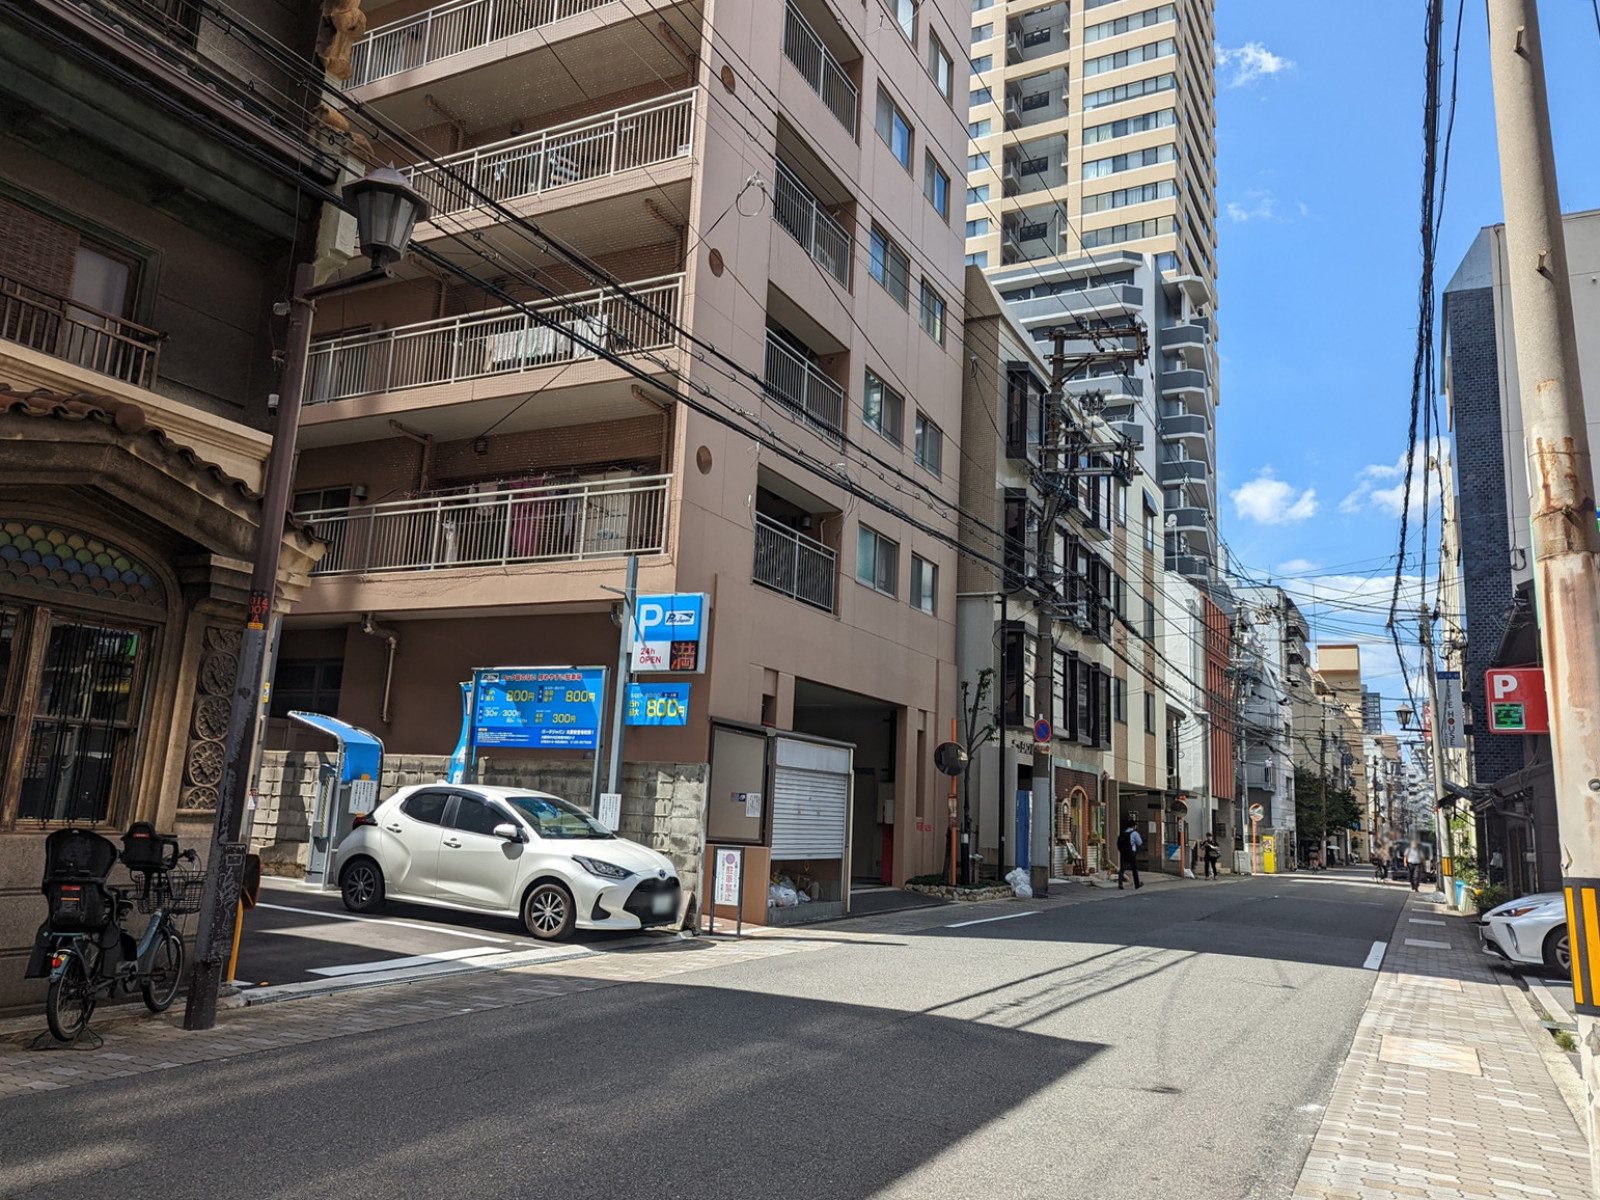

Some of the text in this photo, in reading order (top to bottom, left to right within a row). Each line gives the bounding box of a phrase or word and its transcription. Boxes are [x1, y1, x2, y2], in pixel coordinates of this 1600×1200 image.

[252, 614, 260, 622] A
[638, 604, 663, 641] P
[640, 656, 661, 664] OPEN
[671, 642, 696, 670] 満
[1493, 674, 1518, 699] P
[506, 690, 535, 702] 800円
[565, 690, 596, 703] 800円
[646, 698, 685, 717] 800円
[552, 714, 576, 723] 300円
